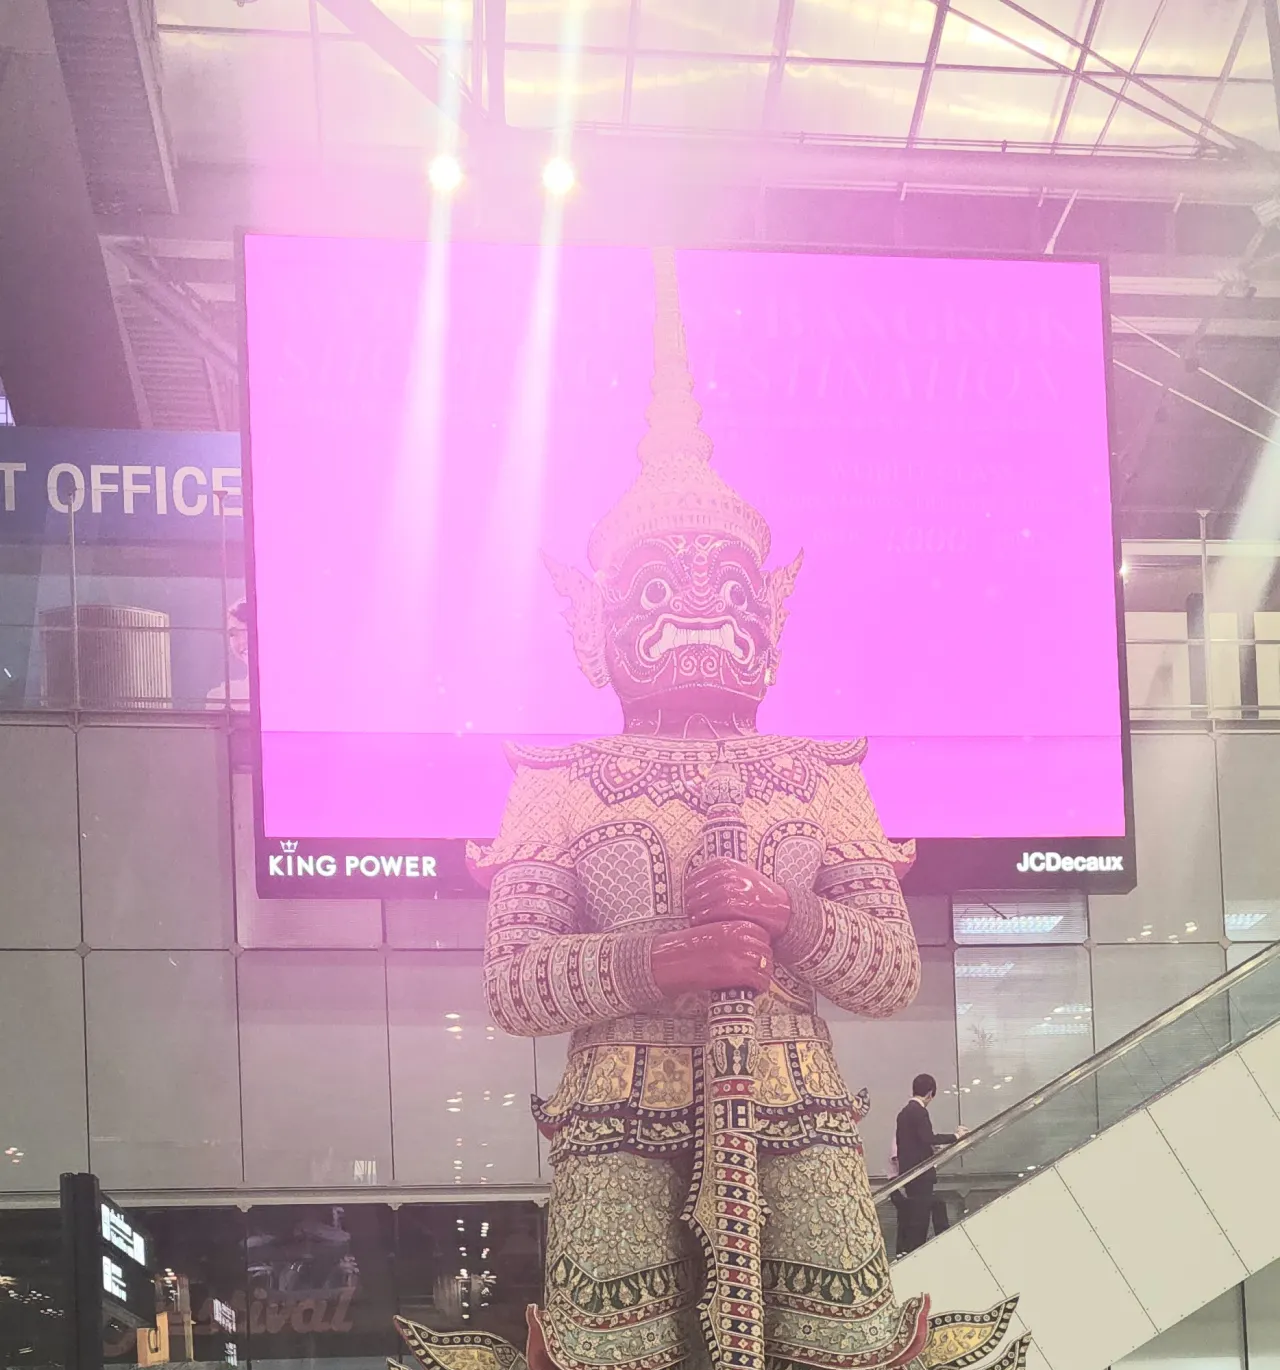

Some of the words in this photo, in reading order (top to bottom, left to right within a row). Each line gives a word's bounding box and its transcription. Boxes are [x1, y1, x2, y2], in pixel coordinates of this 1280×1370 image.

[47, 462, 243, 516] OFFICE
[268, 855, 337, 877] KING
[345, 855, 437, 877] POWER
[1016, 851, 1124, 873] JCDecaux
